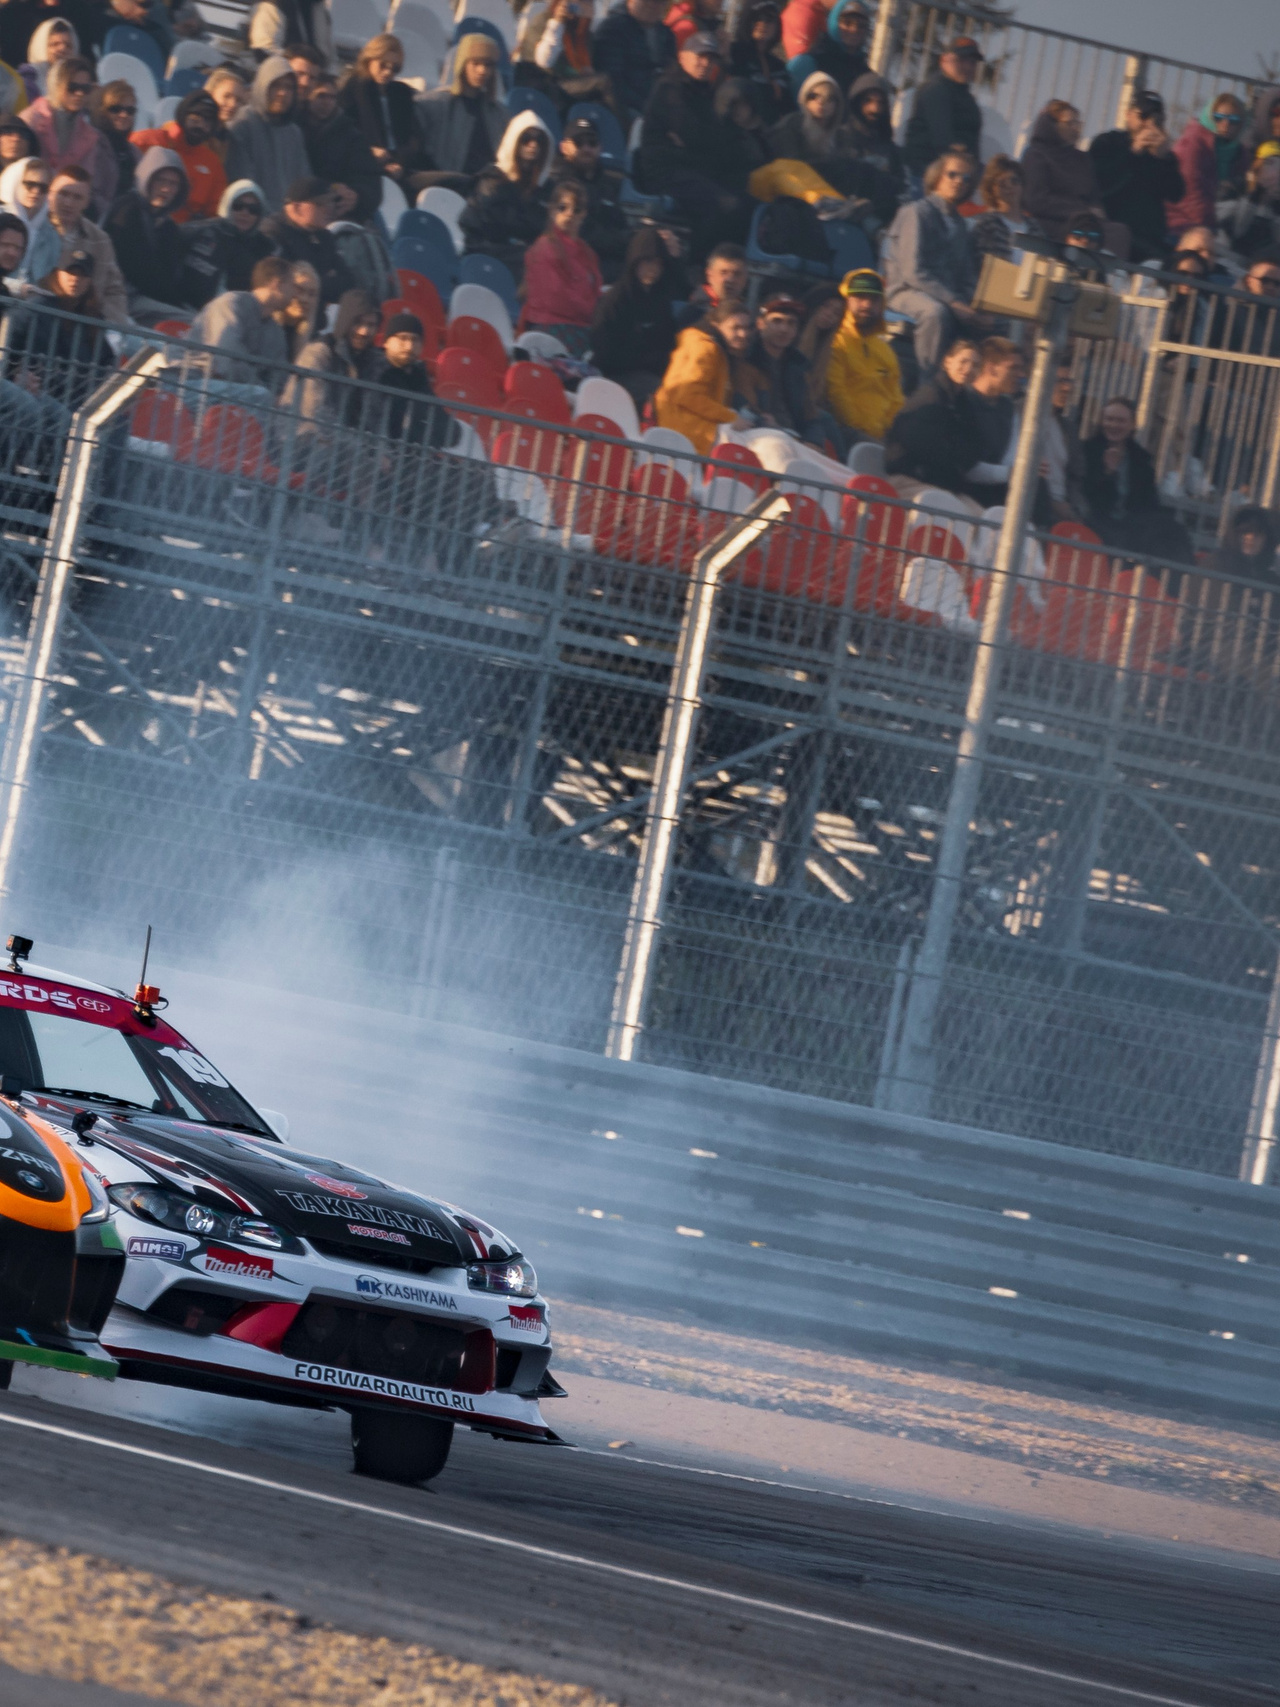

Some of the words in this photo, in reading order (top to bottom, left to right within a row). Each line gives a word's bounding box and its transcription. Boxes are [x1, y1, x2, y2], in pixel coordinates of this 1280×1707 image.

[77, 996, 111, 1013] GP
[157, 1046, 230, 1088] 19
[274, 1189, 452, 1244] TAKAYAMA
[129, 1242, 181, 1258] AIMOL
[347, 1223, 389, 1242] MOTOR
[390, 1232, 412, 1246] OIL
[355, 1279, 384, 1295] MK
[384, 1284, 458, 1311] KASHIYAMA
[295, 1363, 475, 1412] FORWARDAUTO.RU
